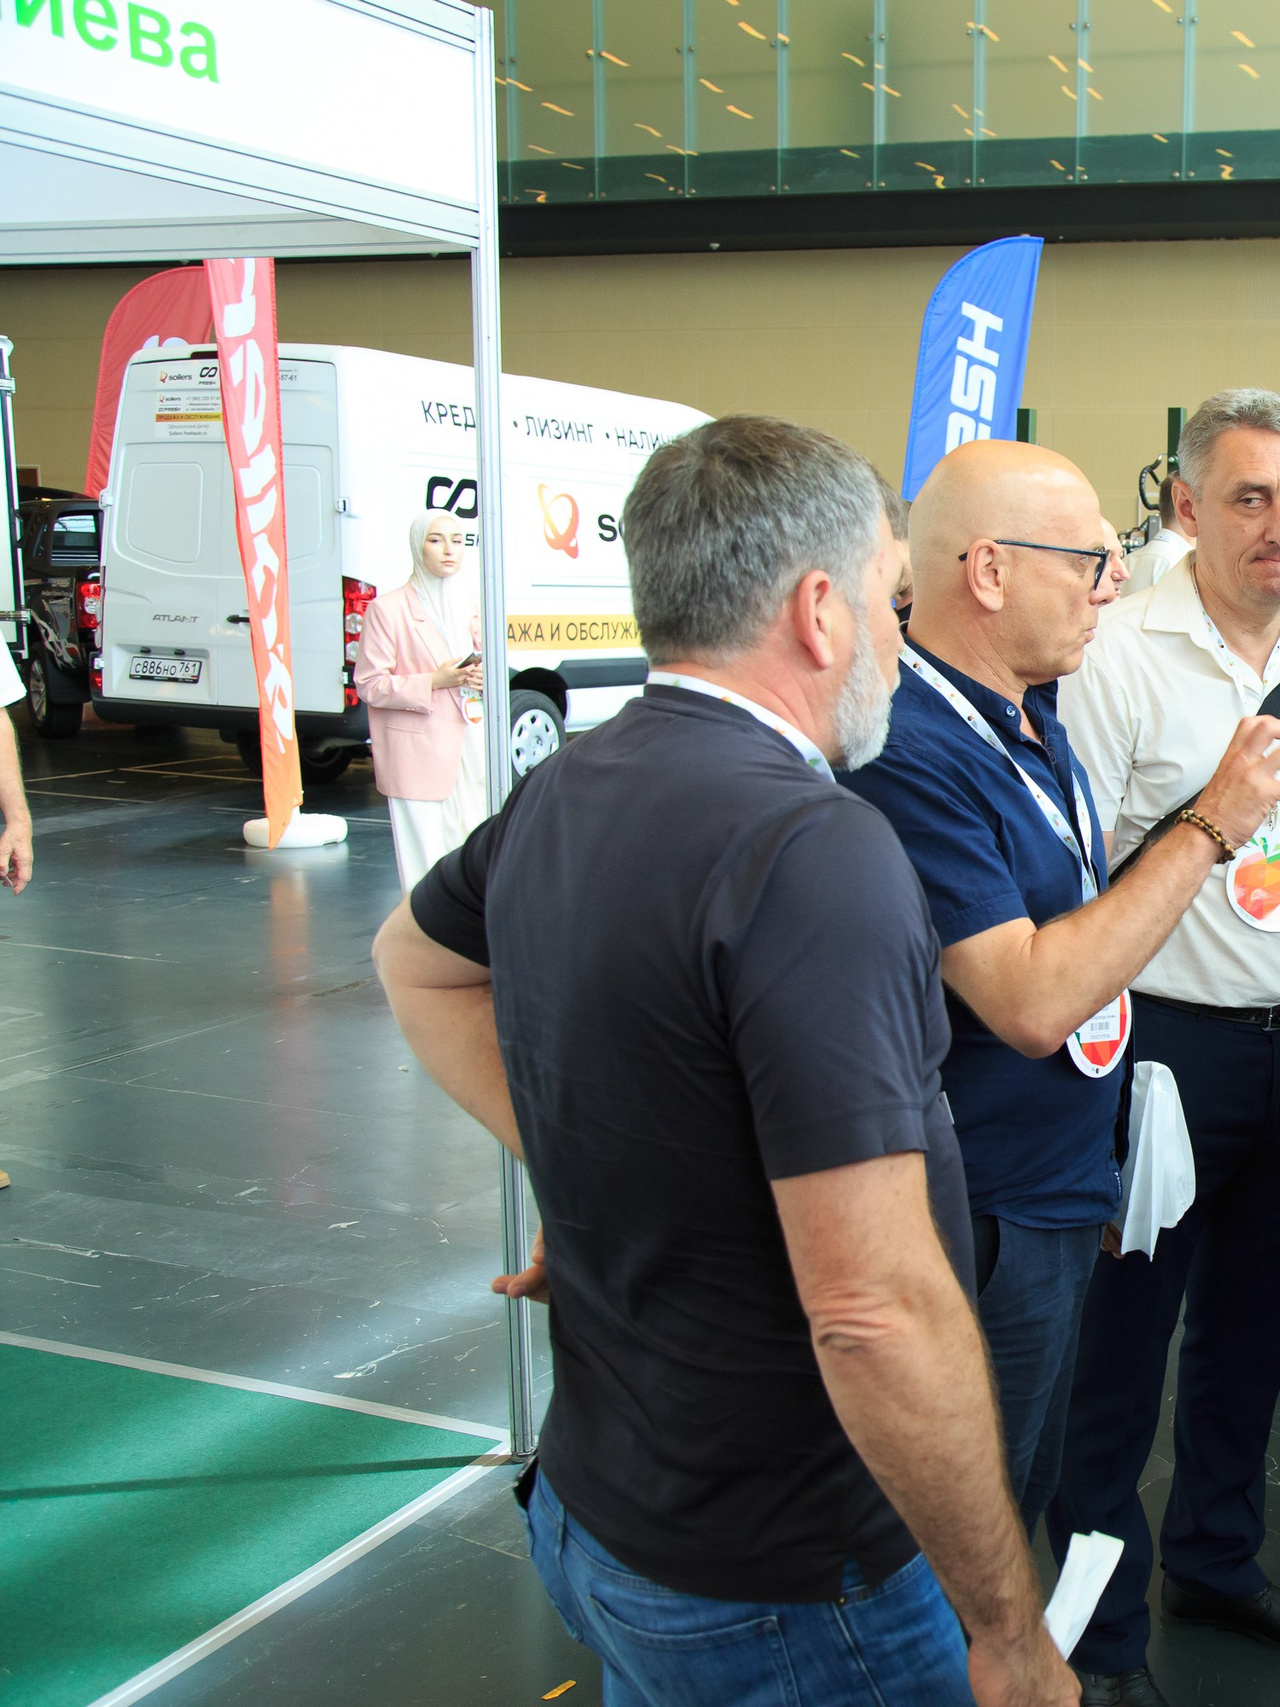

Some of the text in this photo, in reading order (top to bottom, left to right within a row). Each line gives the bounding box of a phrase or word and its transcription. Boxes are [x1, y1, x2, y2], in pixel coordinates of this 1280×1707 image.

[0, 0, 220, 84] иева
[421, 400, 476, 431] КРЕД
[525, 415, 594, 444] ЛИЗИНГ
[152, 614, 199, 623] ATLANT
[507, 623, 544, 642] АЖА
[550, 623, 560, 641] И
[180, 662, 197, 673] 761
